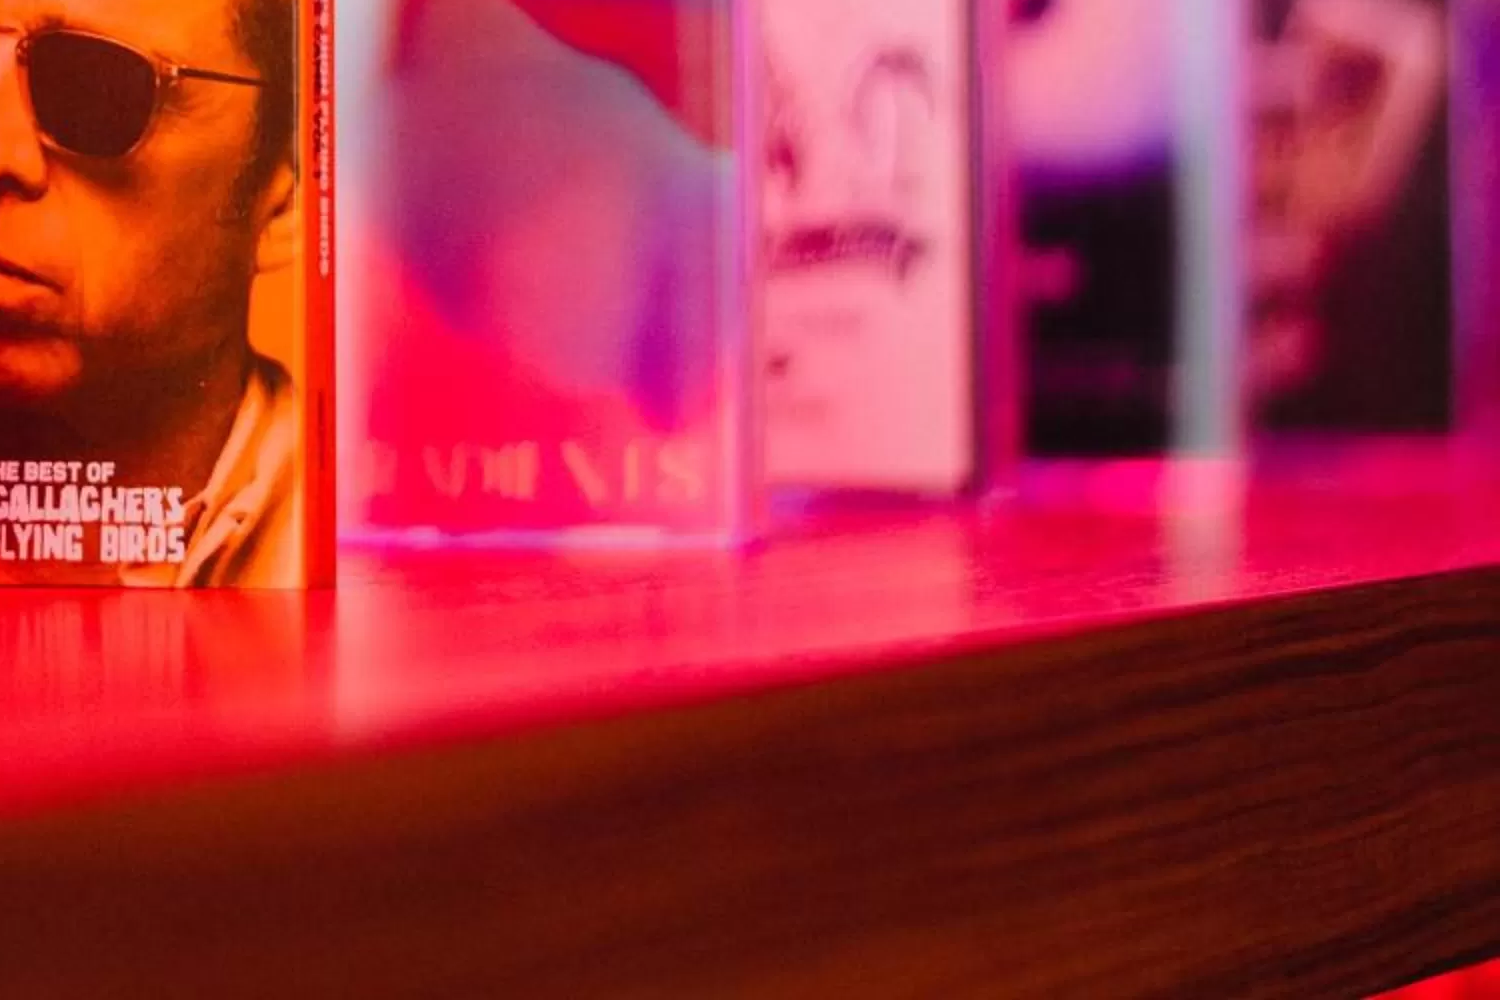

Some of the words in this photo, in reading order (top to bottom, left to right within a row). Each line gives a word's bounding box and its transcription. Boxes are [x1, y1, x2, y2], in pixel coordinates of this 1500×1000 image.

[23, 461, 83, 482] BEST
[87, 461, 115, 482] OF
[101, 524, 185, 562] BIRDS
